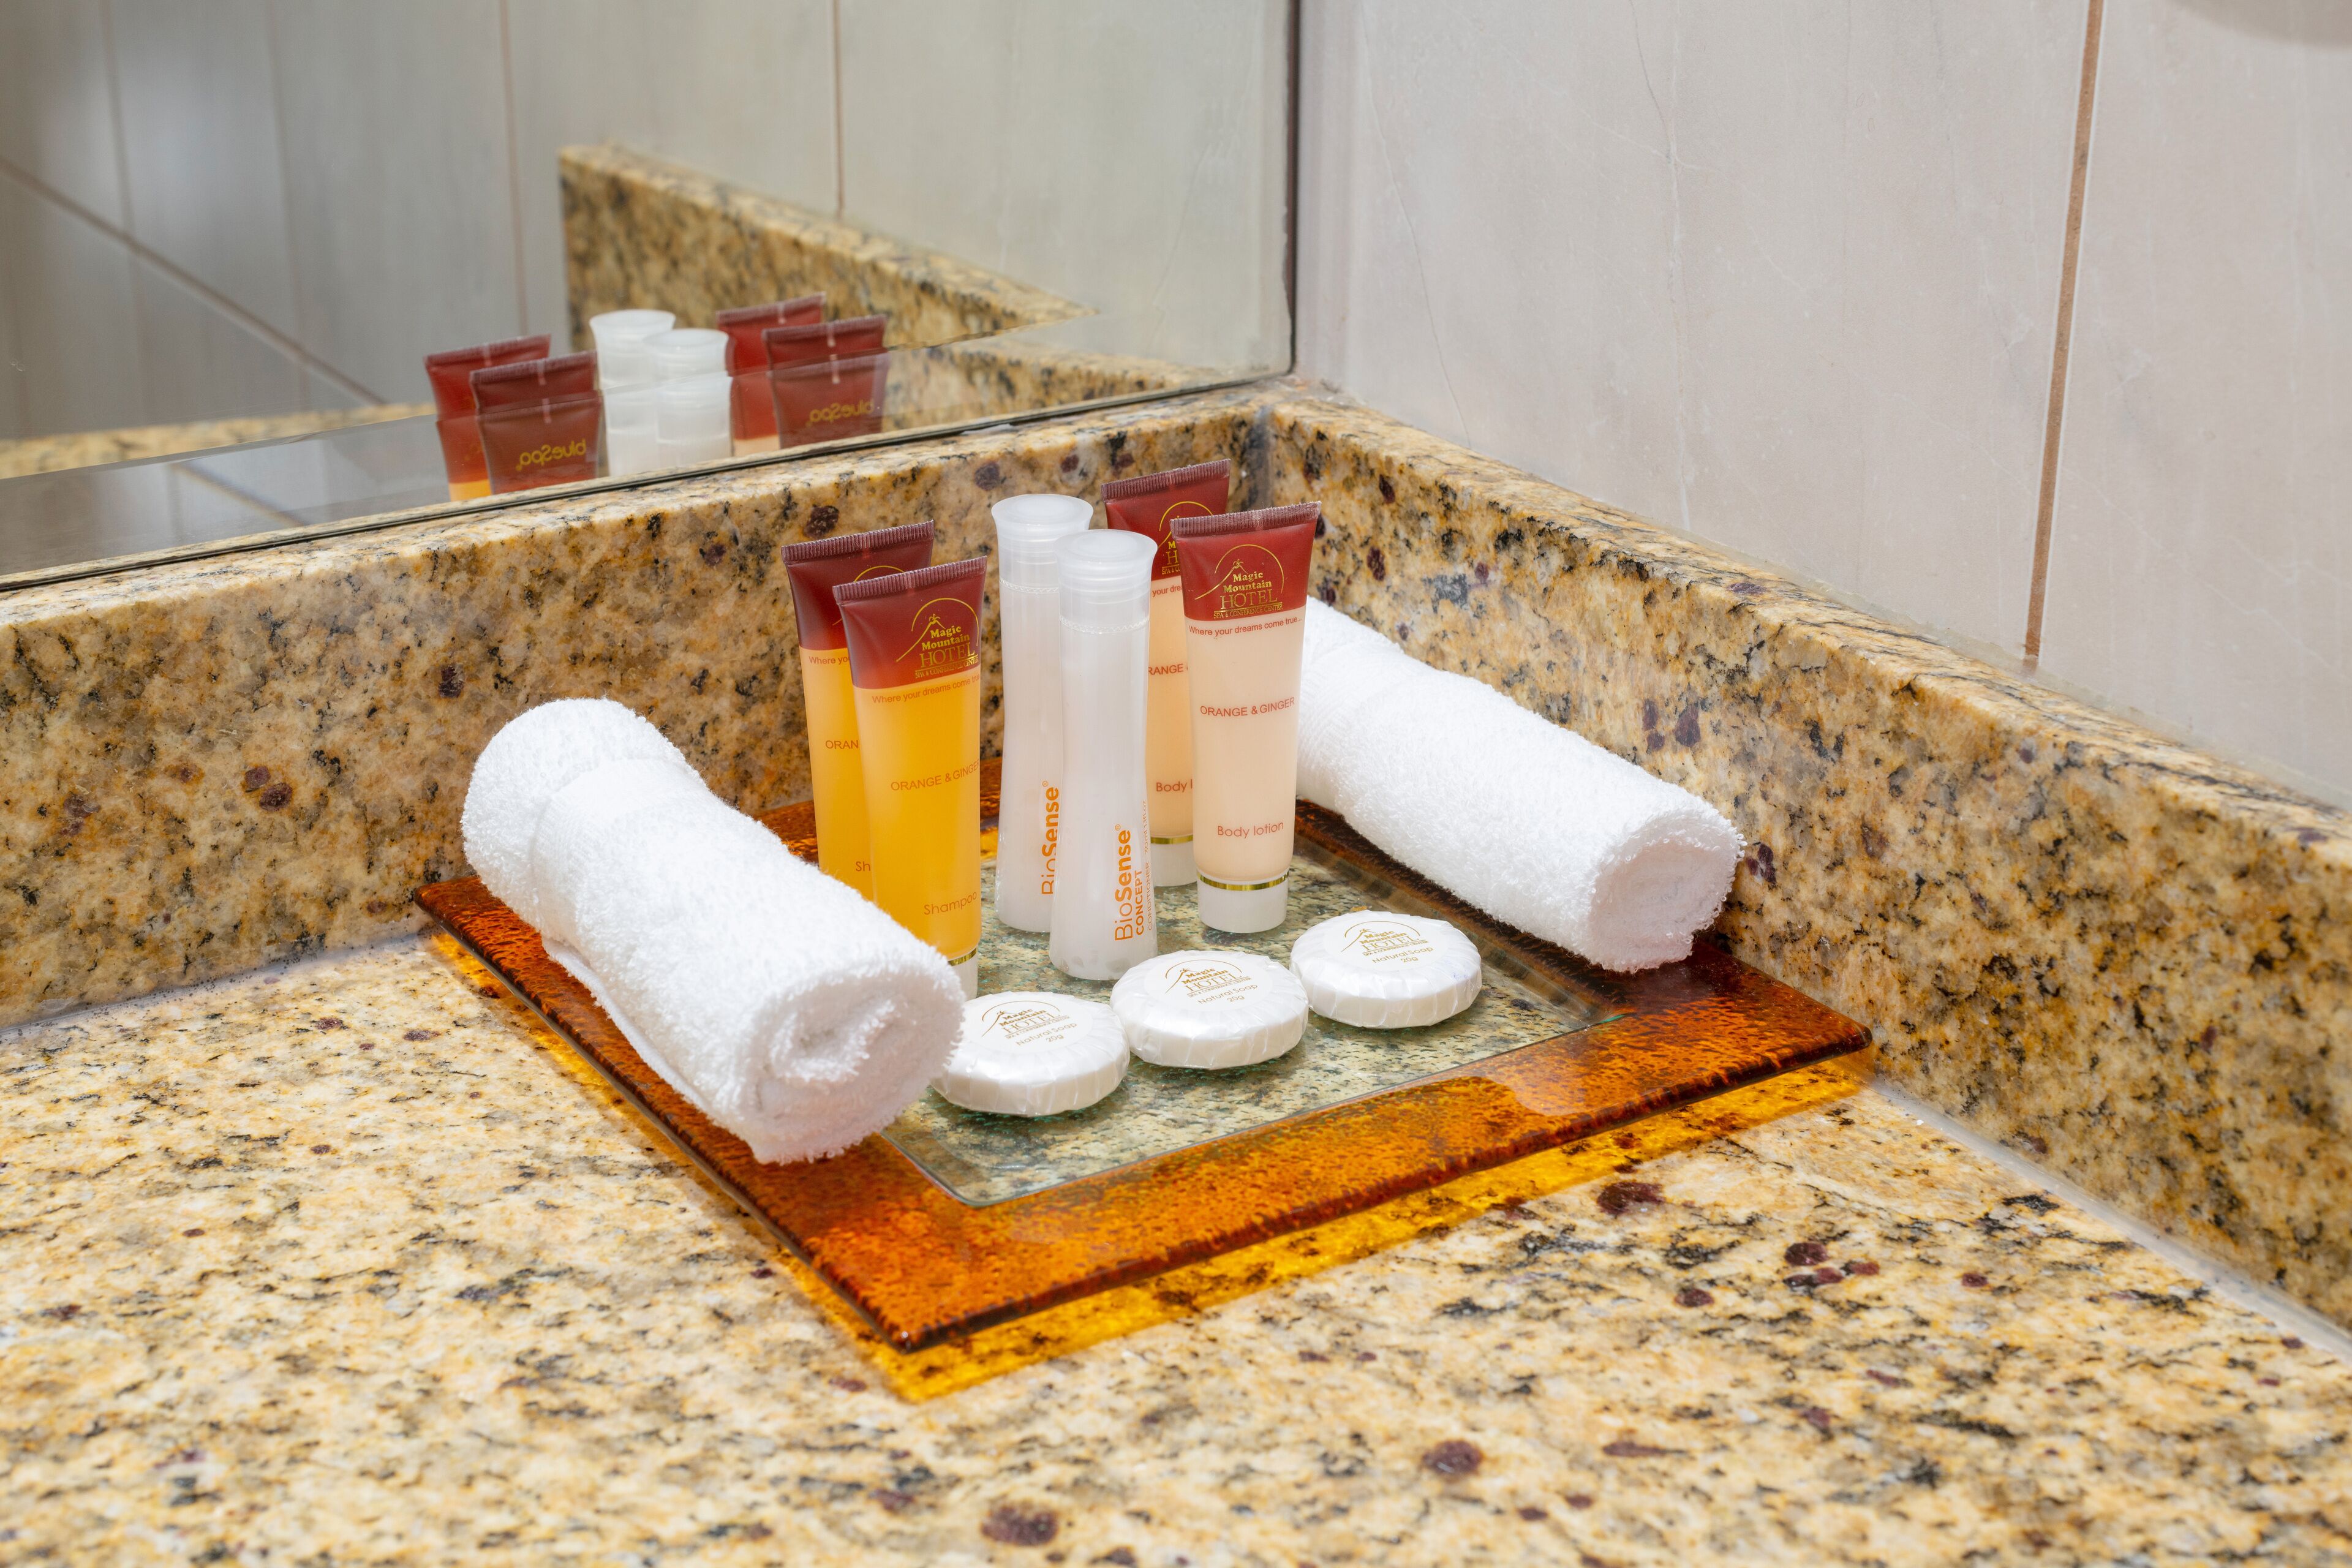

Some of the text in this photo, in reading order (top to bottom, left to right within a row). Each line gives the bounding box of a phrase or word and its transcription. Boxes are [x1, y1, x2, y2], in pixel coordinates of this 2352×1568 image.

[1233, 571, 1263, 582] Magic
[1152, 587, 1169, 598] your
[1223, 580, 1272, 593] Mountain
[1220, 589, 1278, 609] HOTEL
[1229, 606, 1263, 617] CONFERENCE
[930, 625, 961, 639] Magic
[1189, 625, 1213, 636] Where
[1215, 628, 1233, 636] your
[1235, 624, 1262, 633] dreams
[1264, 619, 1284, 629] come
[921, 634, 970, 650] Mountain
[809, 656, 850, 665] Where yo
[919, 642, 975, 668] HOTEL
[872, 695, 902, 703] Where
[903, 691, 921, 702] your
[922, 684, 951, 696] dreams
[952, 679, 970, 689] come
[1200, 696, 1295, 717] ORANGE & GINGER
[891, 775, 942, 791] ORANGE
[944, 773, 951, 782] &
[1156, 781, 1187, 793] Body
[1218, 821, 1284, 839] Body lotion
[924, 892, 977, 915] Shampoo
[1134, 870, 1144, 935] CONCEPT
[1359, 932, 1407, 944] Mountain
[1364, 930, 1394, 939] Magic
[1362, 936, 1419, 951] HOTEL
[1372, 951, 1408, 963] Natural
[1182, 970, 1229, 984] Mountain
[1186, 968, 1216, 978] Magic
[1185, 973, 1242, 991] HOTEL
[1198, 984, 1258, 1005] Natural Soap
[999, 1010, 1047, 1027] Mountain
[1002, 1009, 1033, 1020] Magic
[1001, 1013, 1060, 1033] HOTEL
[1016, 1030, 1052, 1046] Natural
[1051, 1023, 1077, 1033] Soap
[1046, 1034, 1064, 1042] 20g
